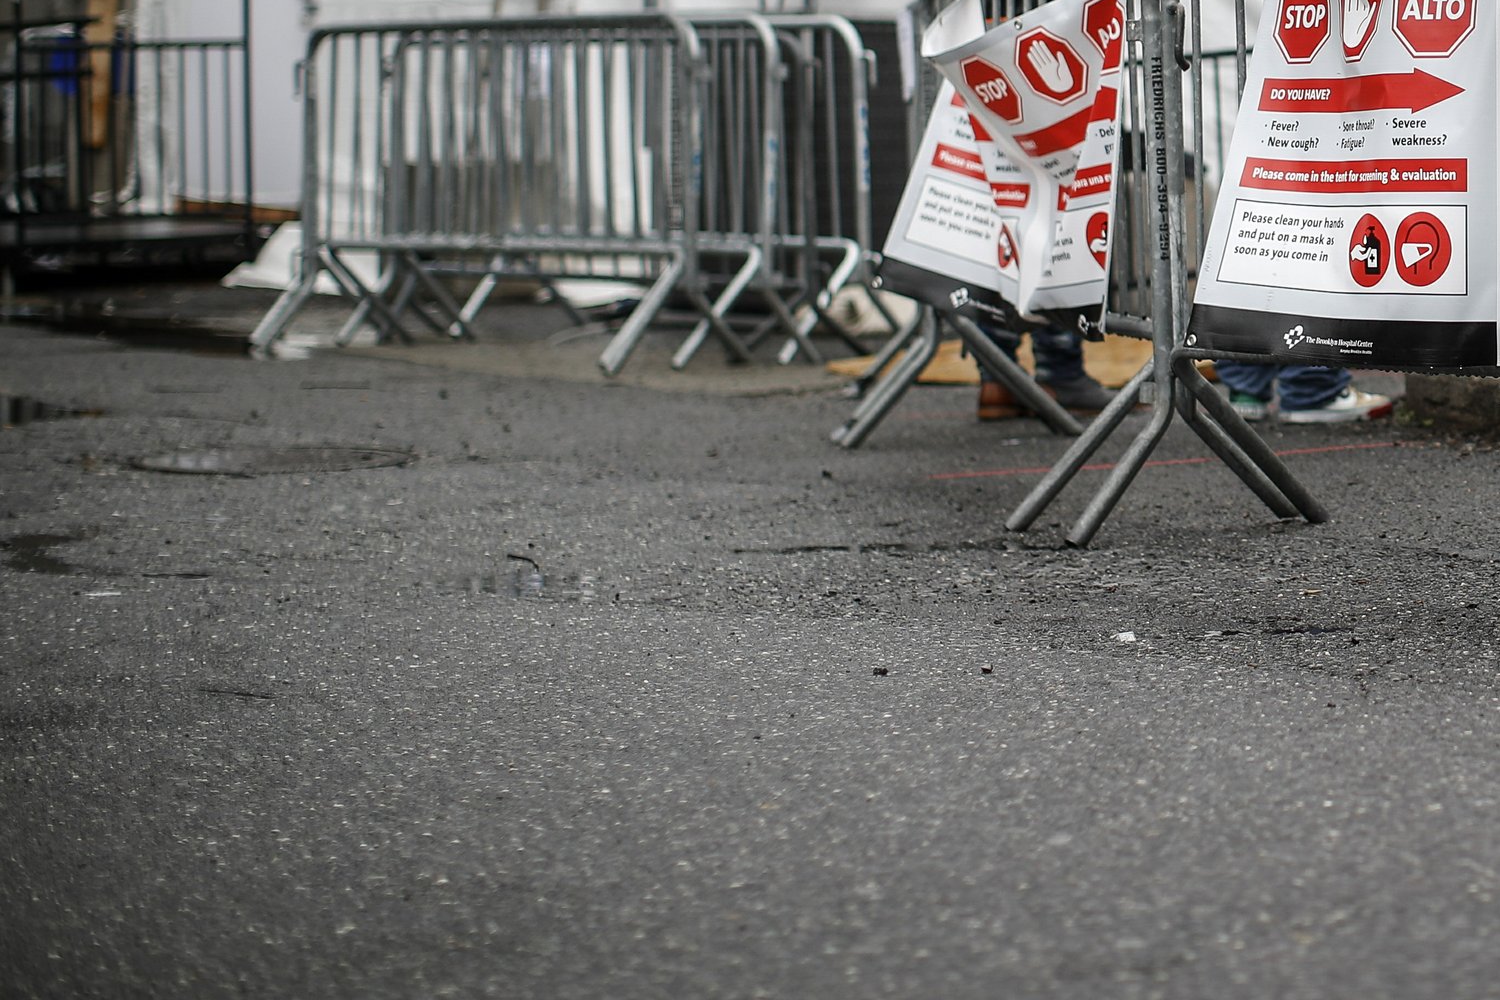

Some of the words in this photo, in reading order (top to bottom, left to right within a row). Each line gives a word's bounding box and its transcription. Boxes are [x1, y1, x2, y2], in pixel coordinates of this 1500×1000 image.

[1285, 4, 1326, 29] STOP
[974, 78, 1009, 105] STOP
[1270, 88, 1285, 100] DO
[1286, 88, 1304, 100] YOU
[1304, 88, 1330, 100] HAVE?
[1271, 120, 1299, 132] Fever?
[1342, 121, 1354, 132] Sore
[1356, 118, 1375, 131] throat?
[1392, 118, 1426, 129] Severe
[1268, 137, 1288, 148] New
[1291, 138, 1320, 151] cough?
[1340, 136, 1365, 151] Fatigue?
[1392, 134, 1447, 146] weakness?
[1252, 167, 1284, 180] Please
[1286, 171, 1310, 182] come
[1310, 170, 1319, 182] in
[1320, 170, 1334, 182] the
[1336, 170, 1348, 182] tent
[1348, 170, 1359, 183] for
[1360, 170, 1388, 184] screening
[1390, 168, 1400, 181] &
[1402, 168, 1456, 182] evaluation
[1242, 212, 1273, 225] Please
[1275, 214, 1300, 226] clean
[1302, 218, 1322, 230] your
[1324, 217, 1344, 229] hands
[1238, 228, 1257, 240] and
[1258, 231, 1275, 245] put
[1278, 234, 1290, 243] on
[1291, 235, 1298, 244] a
[1300, 232, 1324, 246] mask
[1327, 236, 1335, 246] as
[1234, 246, 1255, 256] soon
[1256, 248, 1270, 257] as
[1272, 250, 1290, 261] you
[1292, 250, 1317, 262] come
[1320, 251, 1328, 262] in
[1306, 336, 1315, 344] The
[1316, 337, 1338, 346] Brooklyn
[1338, 339, 1356, 348] Hospital
[1357, 340, 1373, 348] Center
